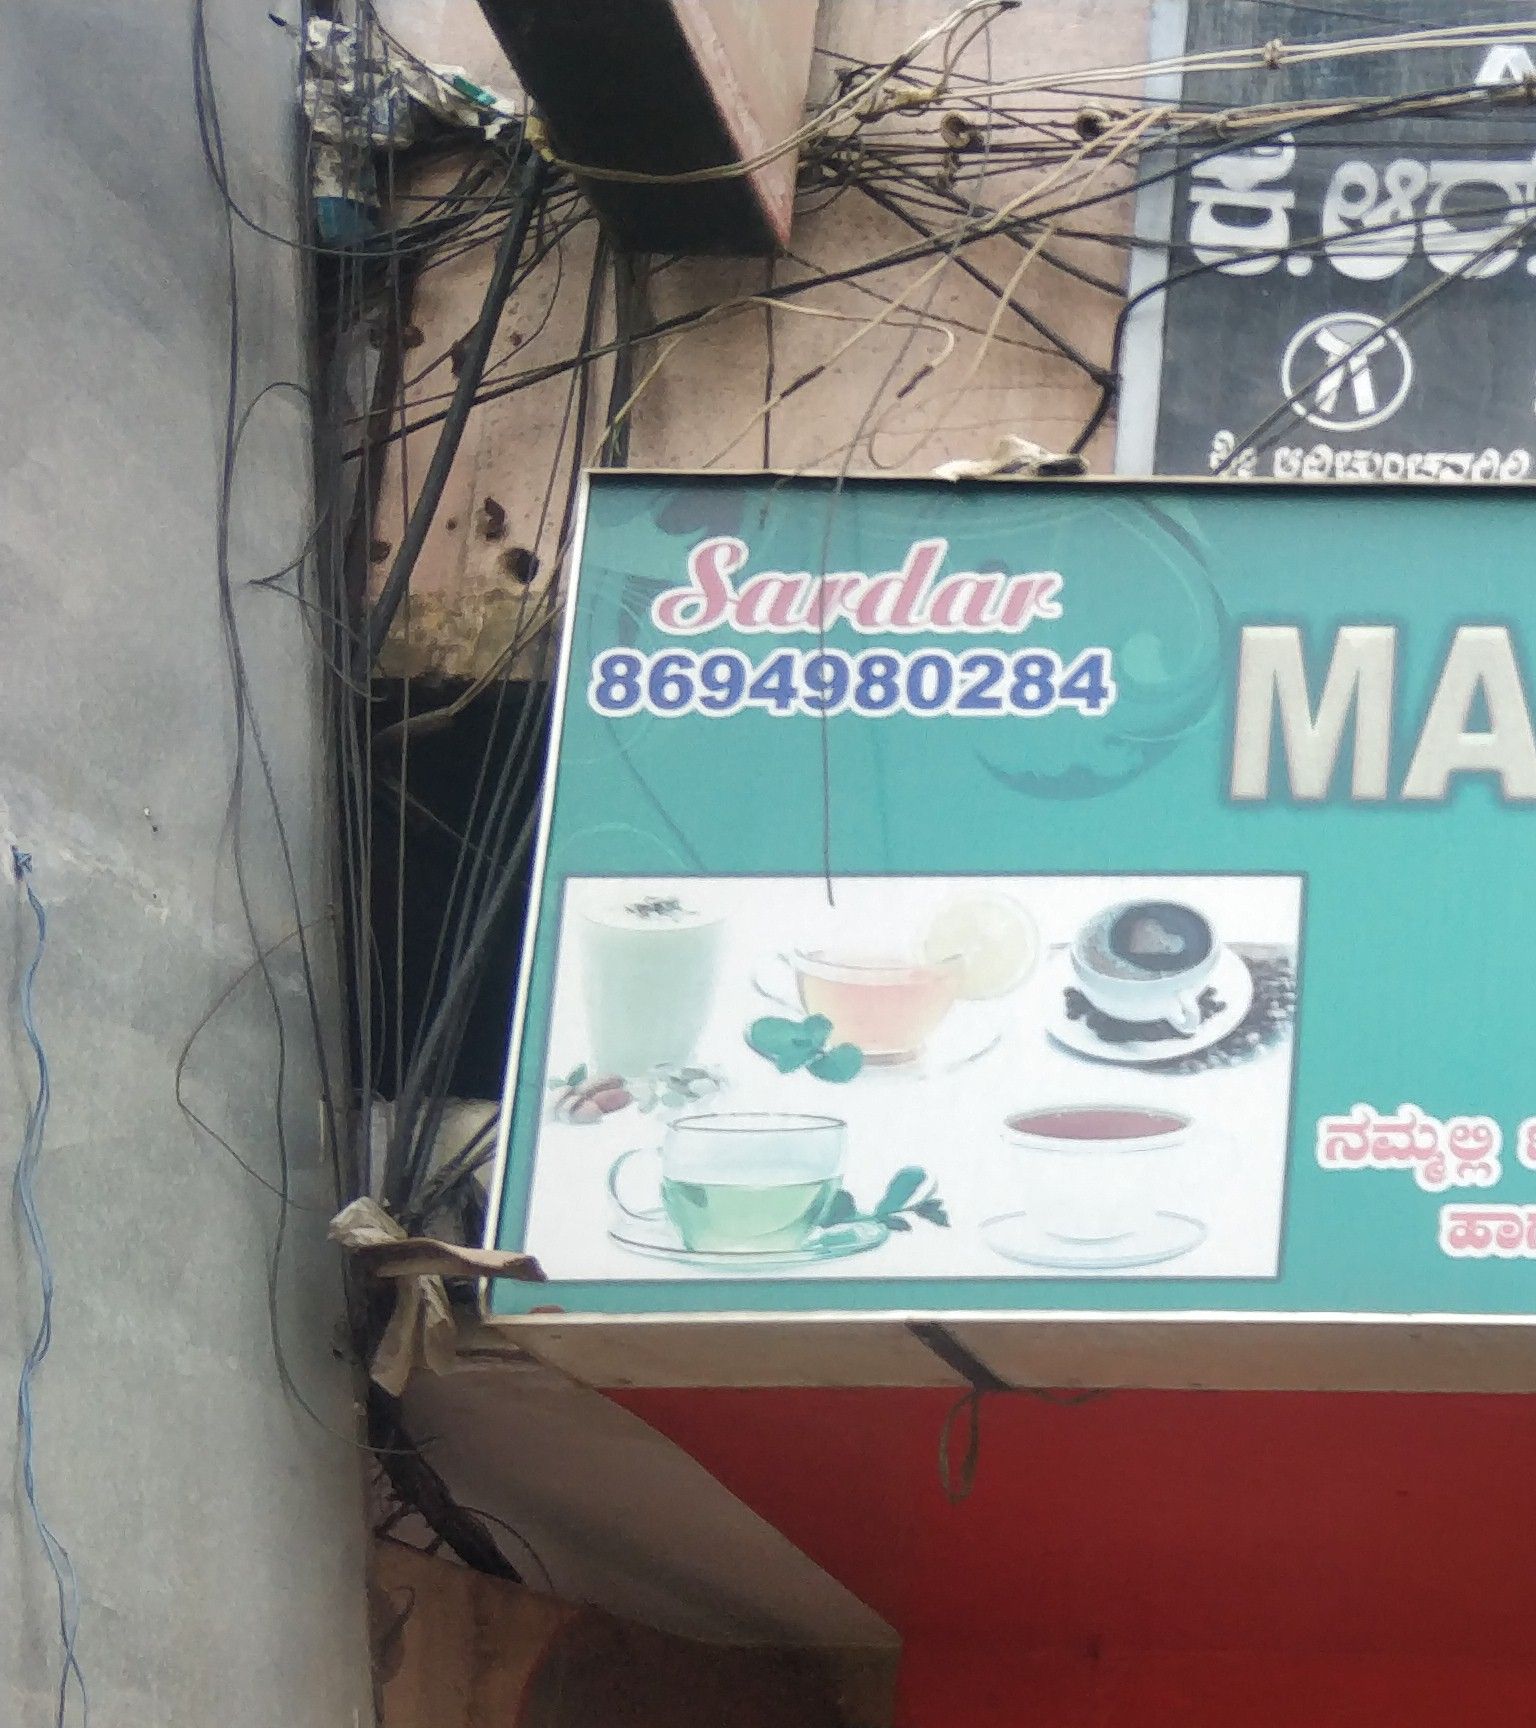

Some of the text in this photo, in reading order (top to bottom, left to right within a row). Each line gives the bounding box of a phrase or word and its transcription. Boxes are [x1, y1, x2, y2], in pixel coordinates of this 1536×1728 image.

[652, 536, 1062, 633] Sardar
[588, 647, 1118, 718] 8694980284
[1318, 1102, 1502, 1191] ನಮ್ಮಲ್ಲಿ
